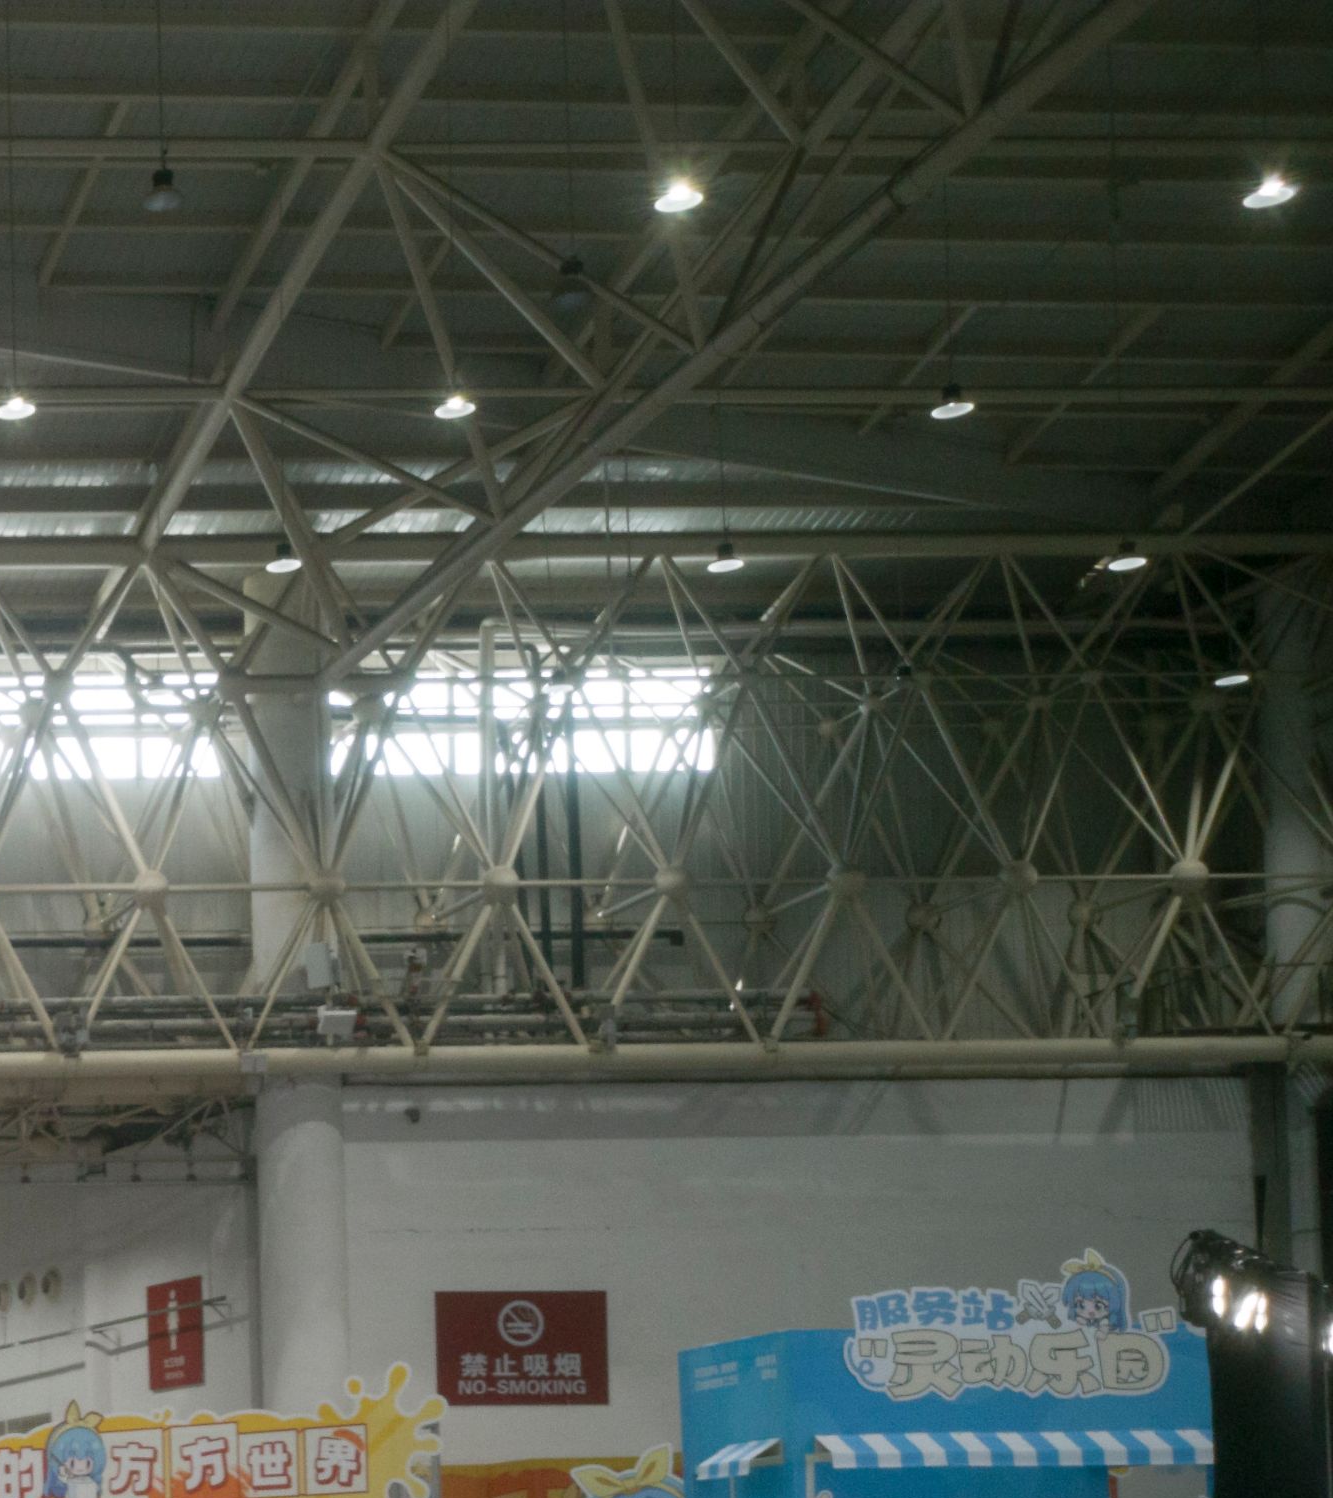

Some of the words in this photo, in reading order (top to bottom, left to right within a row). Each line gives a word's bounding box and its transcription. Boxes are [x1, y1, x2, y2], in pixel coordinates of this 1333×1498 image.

[855, 1290, 1015, 1331] 服务站
[460, 1353, 582, 1377] 禁止吸烟
[457, 1379, 587, 1395] NO-SMOKING
